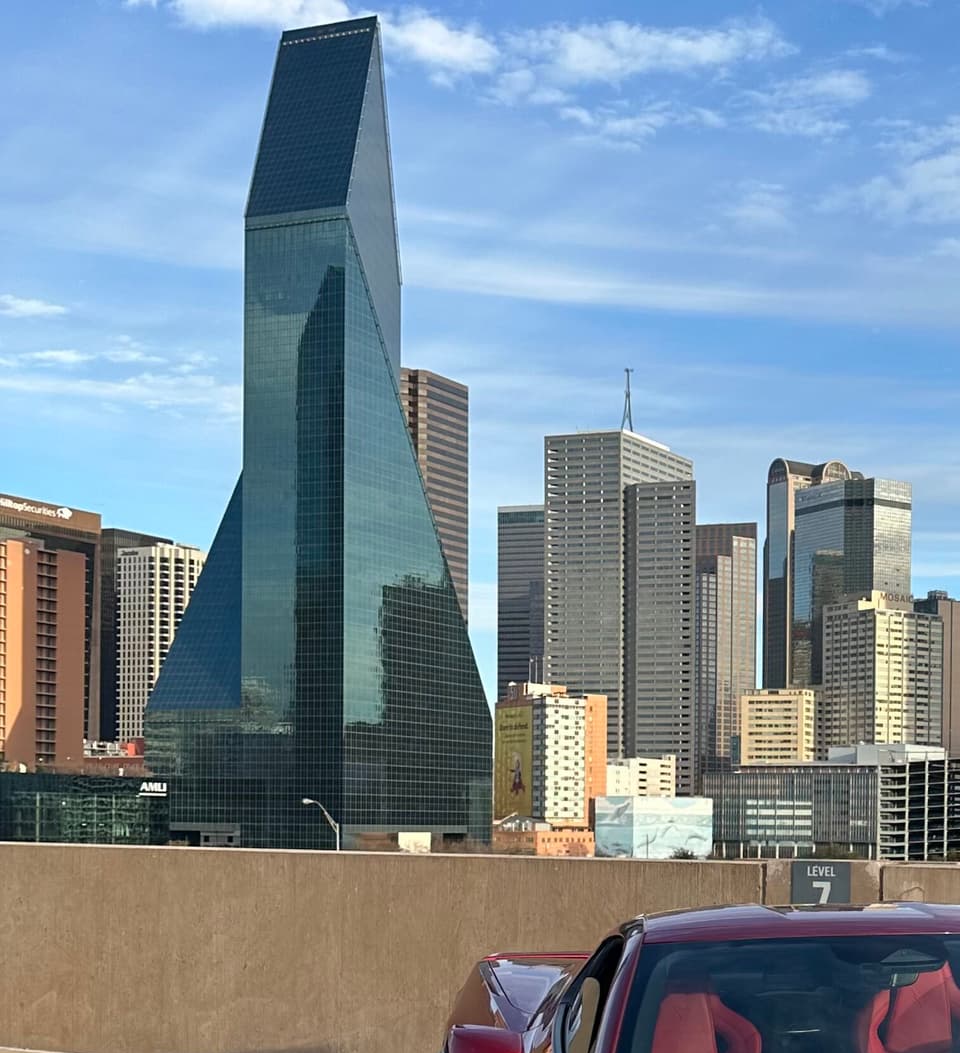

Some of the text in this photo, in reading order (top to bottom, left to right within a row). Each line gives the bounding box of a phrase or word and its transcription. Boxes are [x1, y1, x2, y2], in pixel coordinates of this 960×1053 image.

[880, 592, 914, 604] MOSAIC
[139, 781, 167, 792] AMLI
[807, 865, 836, 877] LEVEL
[812, 881, 831, 904] 7
